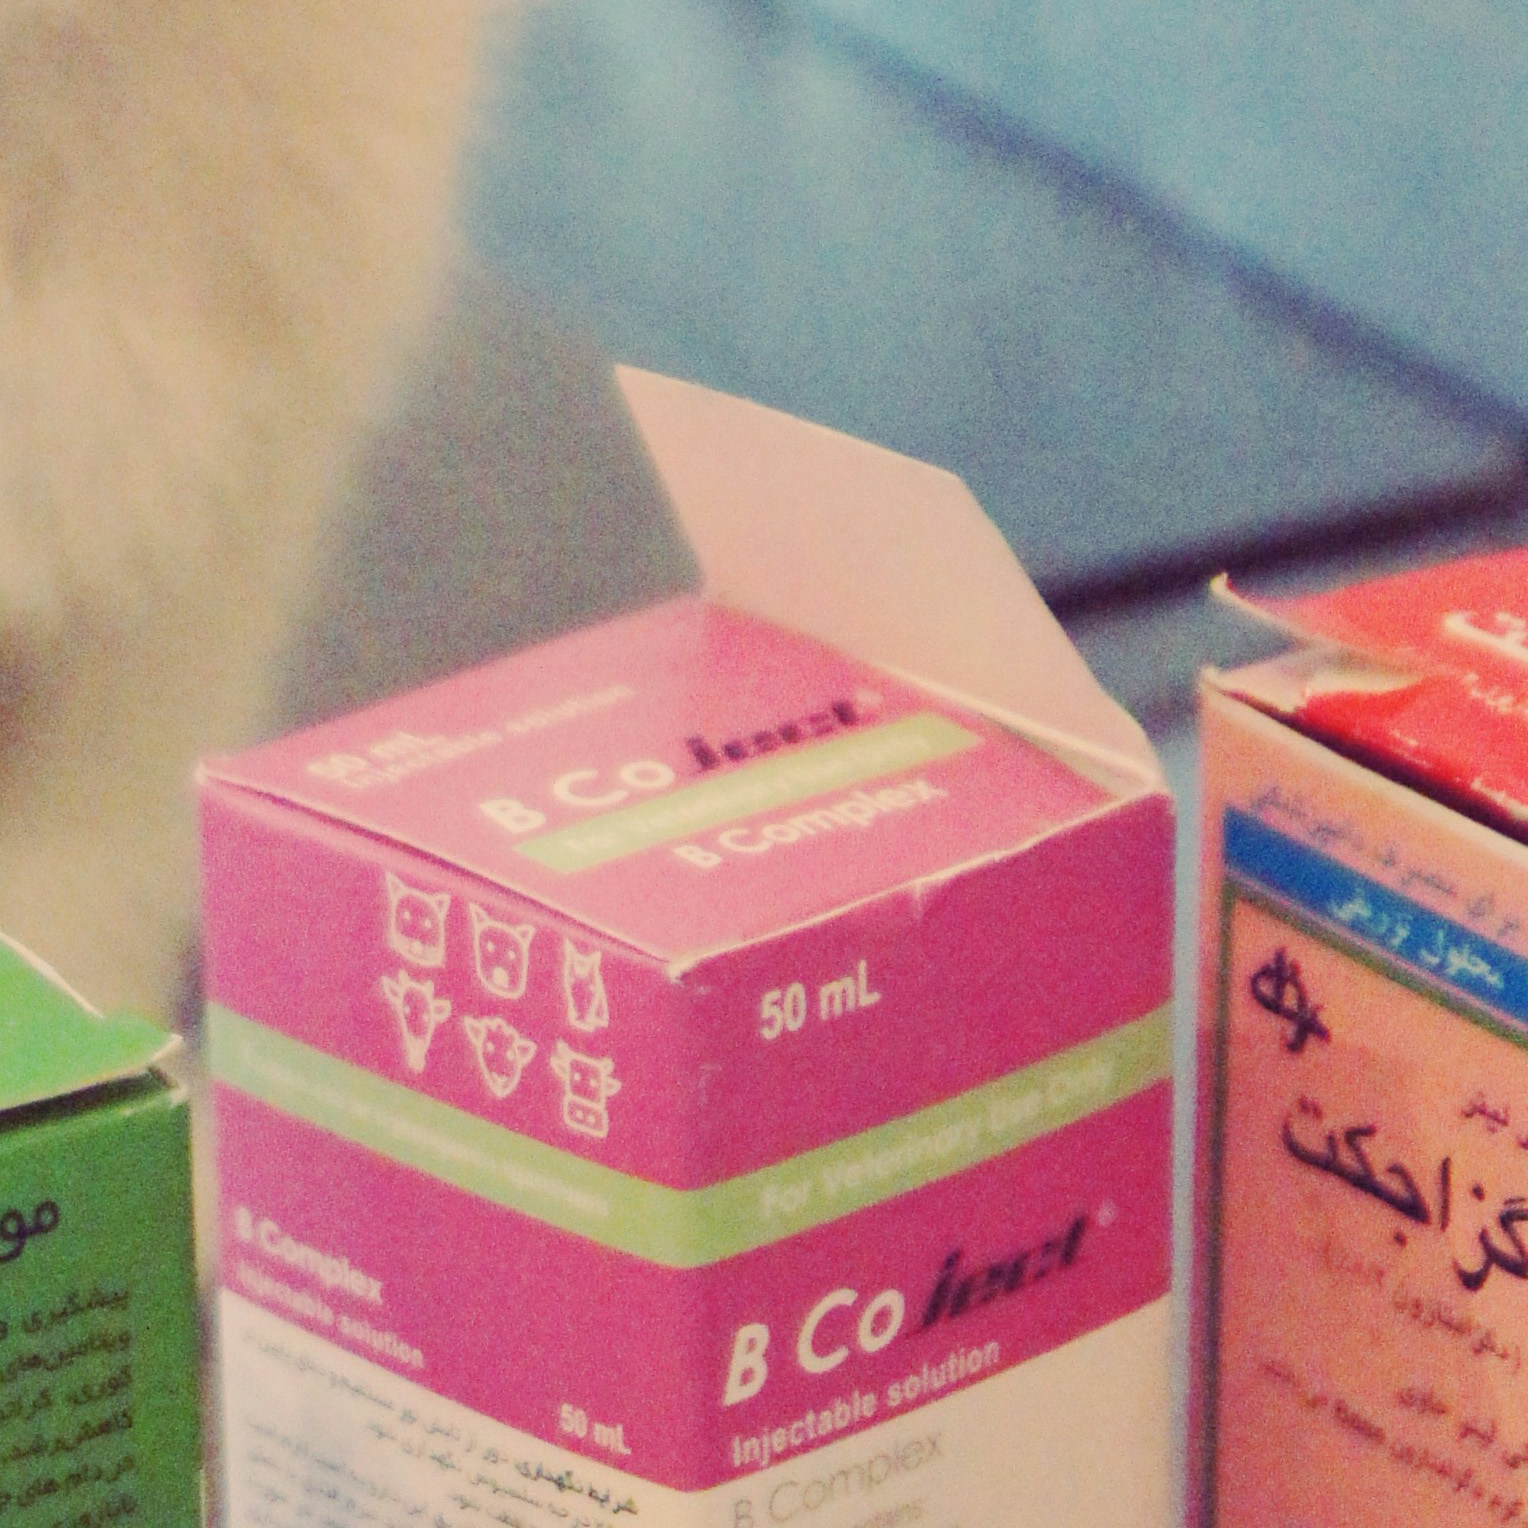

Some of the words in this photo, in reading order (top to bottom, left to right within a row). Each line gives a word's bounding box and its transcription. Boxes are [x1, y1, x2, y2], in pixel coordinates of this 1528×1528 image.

[478, 796, 548, 834] B
[673, 844, 723, 869] B
[718, 775, 948, 855] Complex
[760, 982, 807, 1041] 50
[818, 959, 882, 1021] mL
[723, 1323, 770, 1408] B
[731, 1386, 878, 1470] Injectable
[886, 1339, 1002, 1409] solution
[558, 1402, 589, 1440] 50
[593, 1422, 633, 1457] mL
[767, 1429, 944, 1523] Complex
